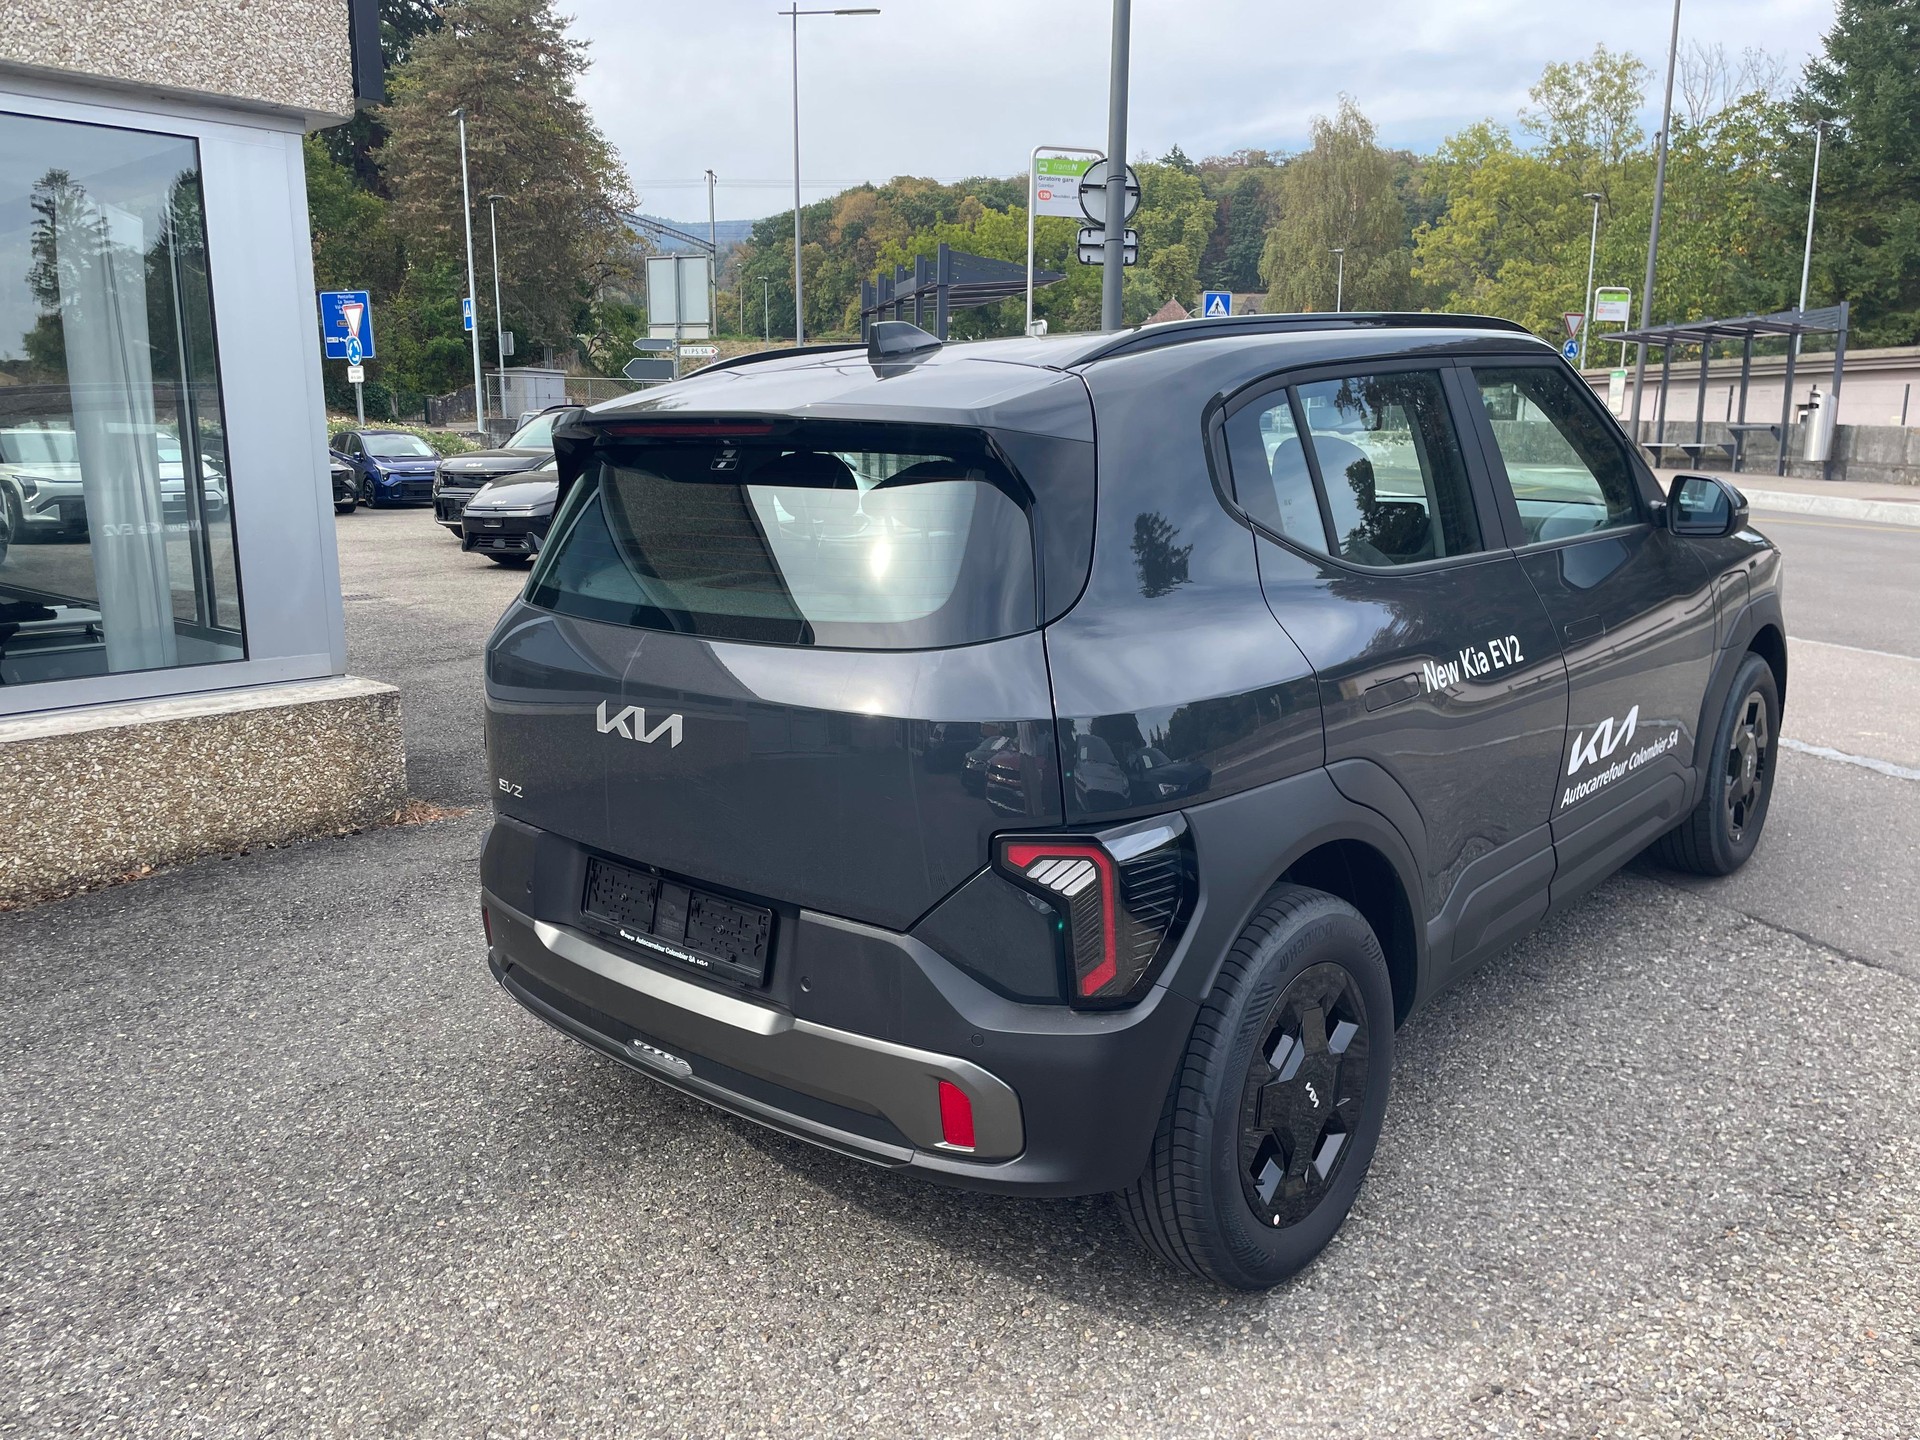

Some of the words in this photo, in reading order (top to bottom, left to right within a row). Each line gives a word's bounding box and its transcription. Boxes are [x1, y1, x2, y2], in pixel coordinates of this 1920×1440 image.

[1423, 655, 1460, 693] New
[1459, 647, 1491, 679] Kia
[1488, 635, 1524, 670] EV2
[596, 699, 683, 749] KIA
[1567, 704, 1640, 776] KIA
[498, 777, 524, 799] EV2
[1560, 759, 1629, 809] Autocarrefour
[1628, 737, 1668, 771] Colombier
[1666, 728, 1679, 748] SA
[636, 936, 666, 954] Autocarrefour
[665, 946, 689, 962] Colombier
[688, 955, 696, 964] SA
